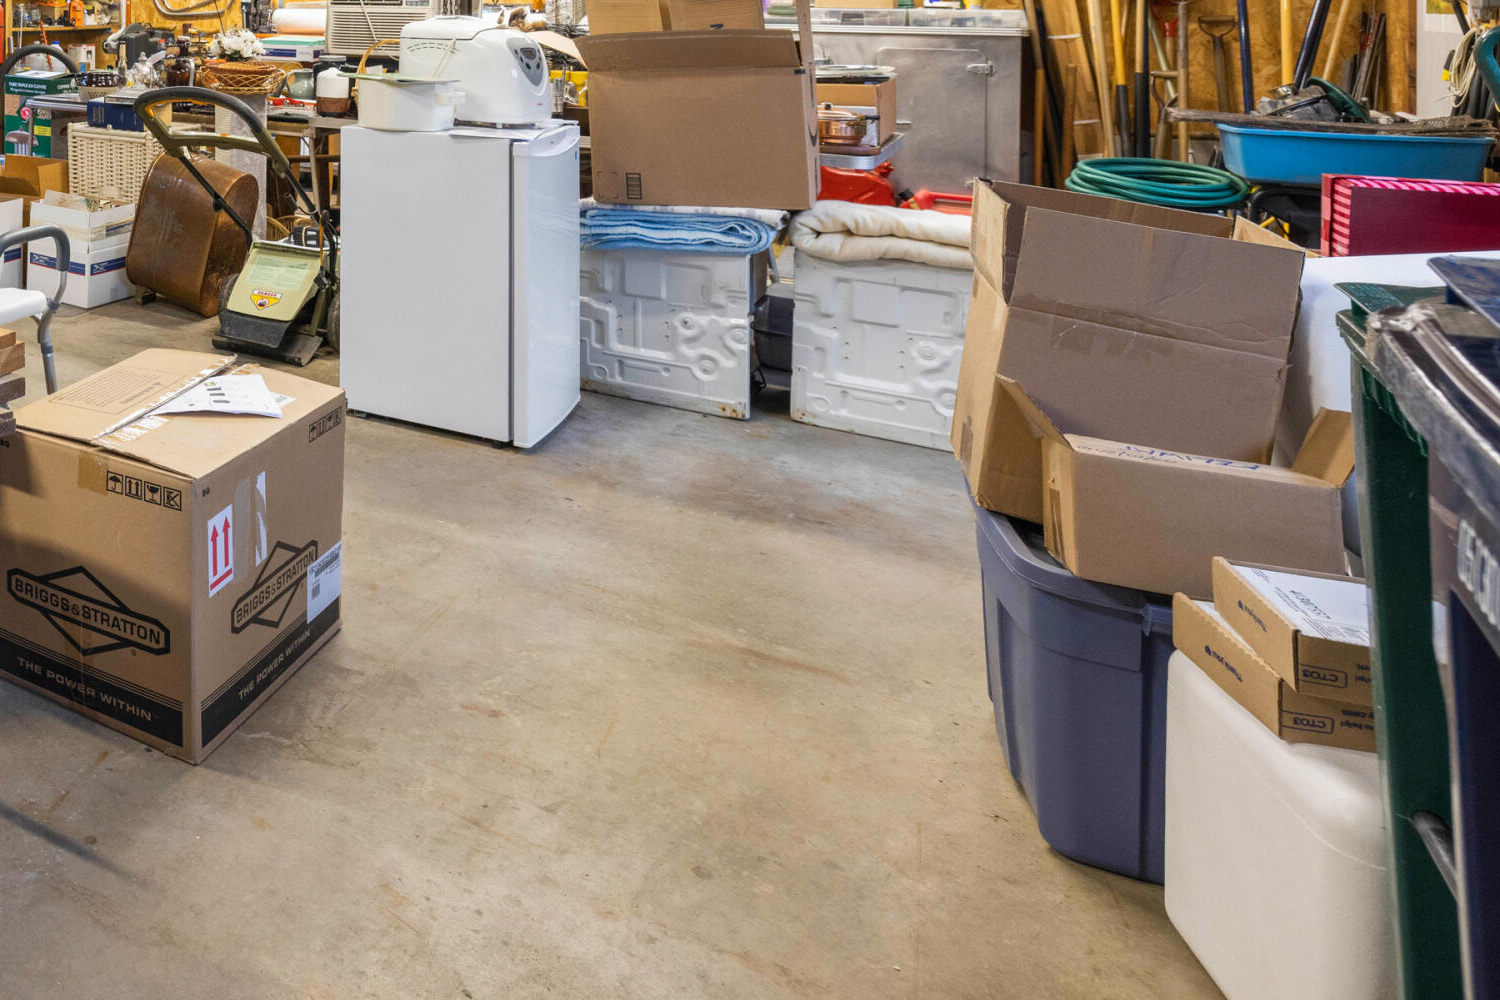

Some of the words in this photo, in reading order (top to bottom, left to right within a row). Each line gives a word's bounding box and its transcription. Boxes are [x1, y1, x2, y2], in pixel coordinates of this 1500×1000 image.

[17, 656, 43, 675] THE
[46, 671, 97, 697] POWER
[100, 692, 152, 721] WITHIN
[238, 679, 255, 700] THE
[256, 653, 284, 684] POWER
[285, 628, 311, 656] WITHIN
